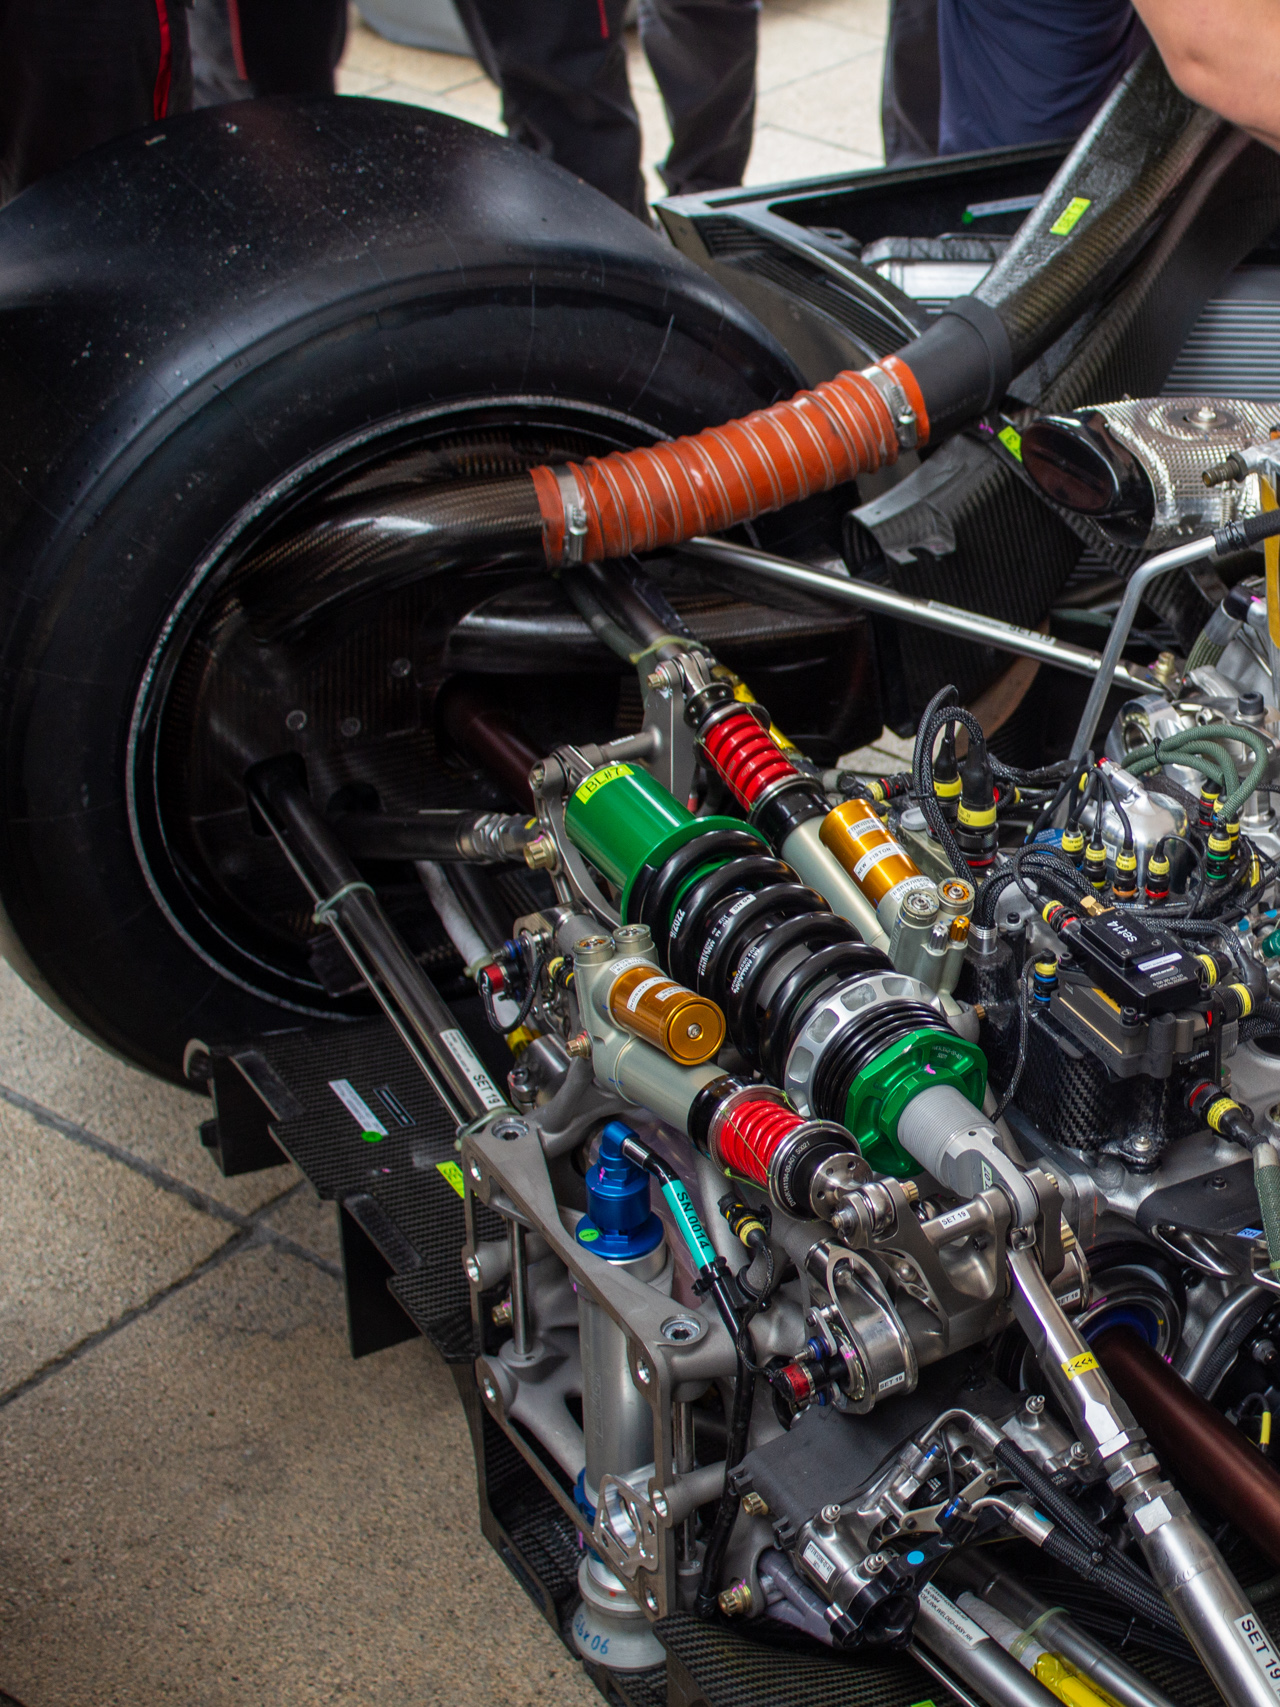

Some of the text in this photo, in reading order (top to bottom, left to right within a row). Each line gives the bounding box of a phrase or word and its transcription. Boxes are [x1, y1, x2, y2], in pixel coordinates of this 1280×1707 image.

[857, 847, 891, 874] NEW PISTON
[1107, 920, 1138, 943] set14
[472, 1072, 499, 1105] SET 19
[675, 1189, 710, 1249] SN.0014
[941, 1210, 966, 1225] SET 19
[1070, 1291, 1078, 1299] 19
[878, 1379, 893, 1389] SET
[589, 1634, 611, 1655] 06
[1240, 1617, 1270, 1655] SET
